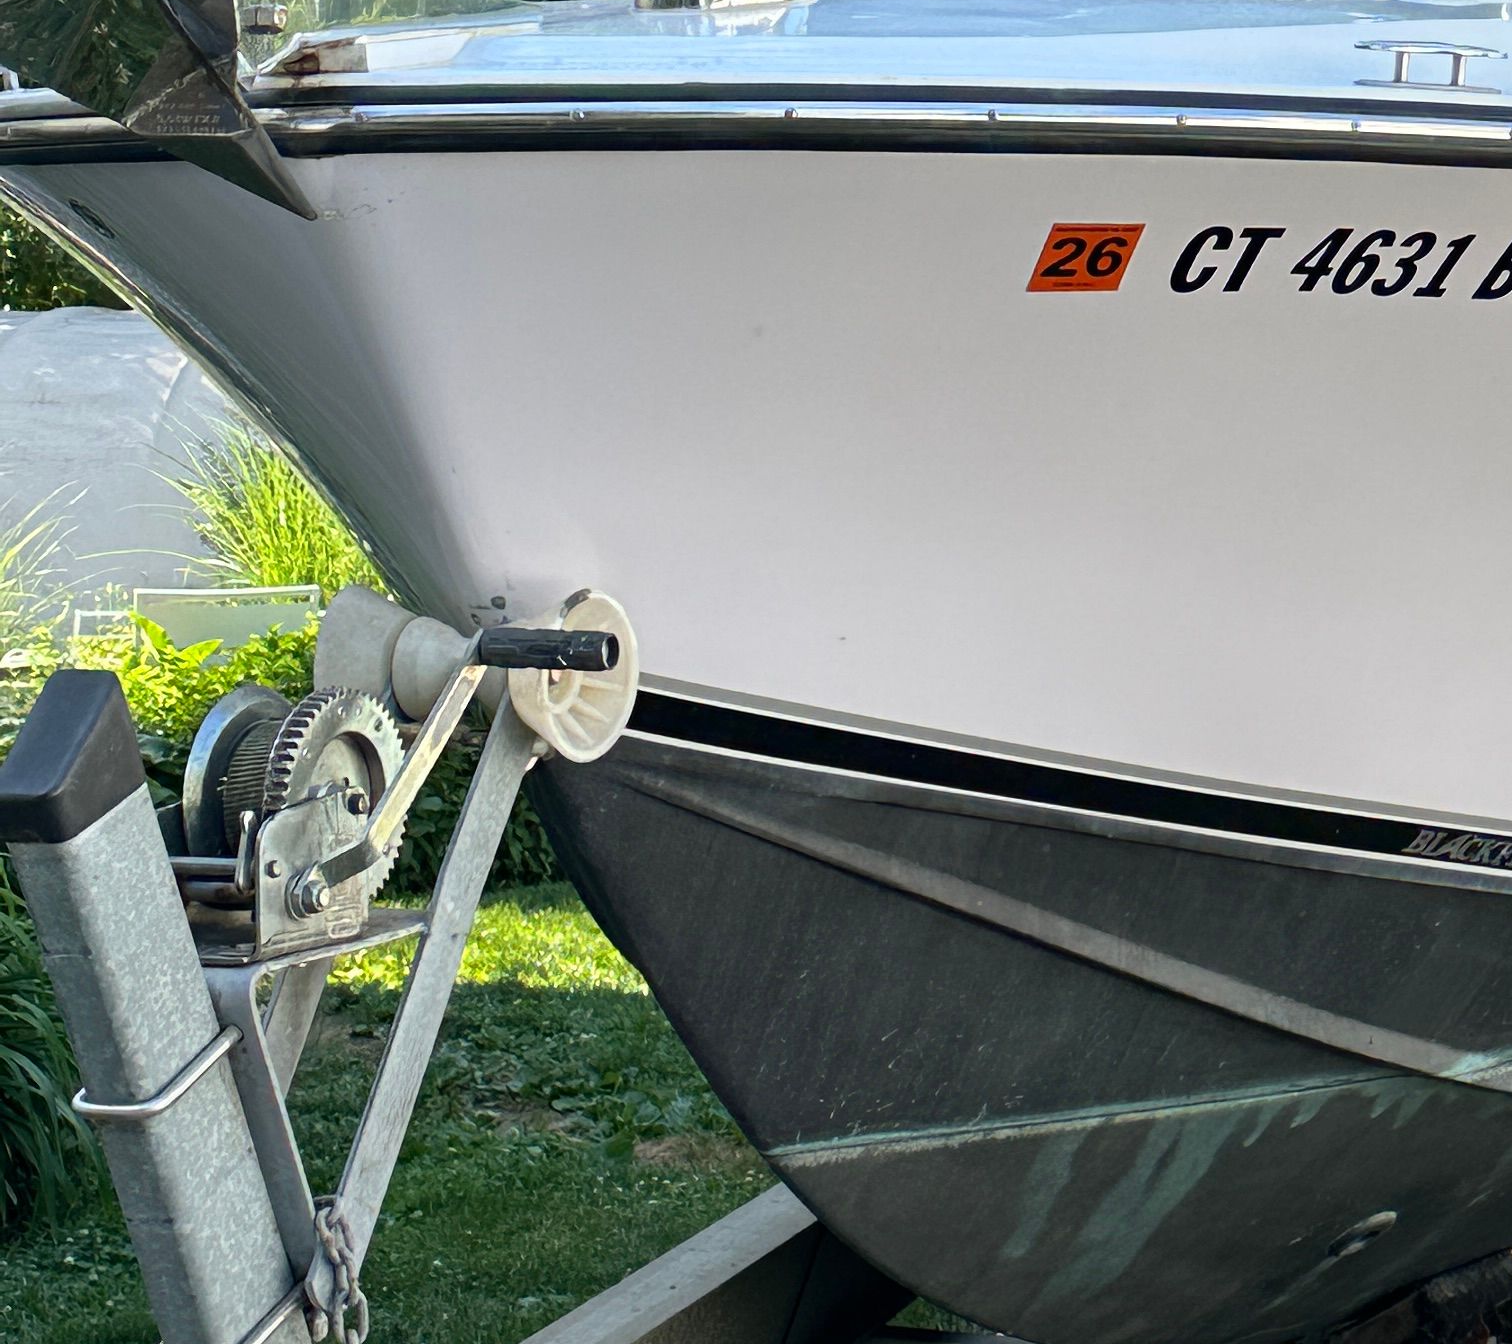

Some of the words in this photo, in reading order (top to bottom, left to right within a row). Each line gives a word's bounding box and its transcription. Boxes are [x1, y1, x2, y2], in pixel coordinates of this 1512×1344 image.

[1040, 237, 1128, 277] 26
[1169, 226, 1286, 293] CT
[1290, 228, 1476, 298] 4631
